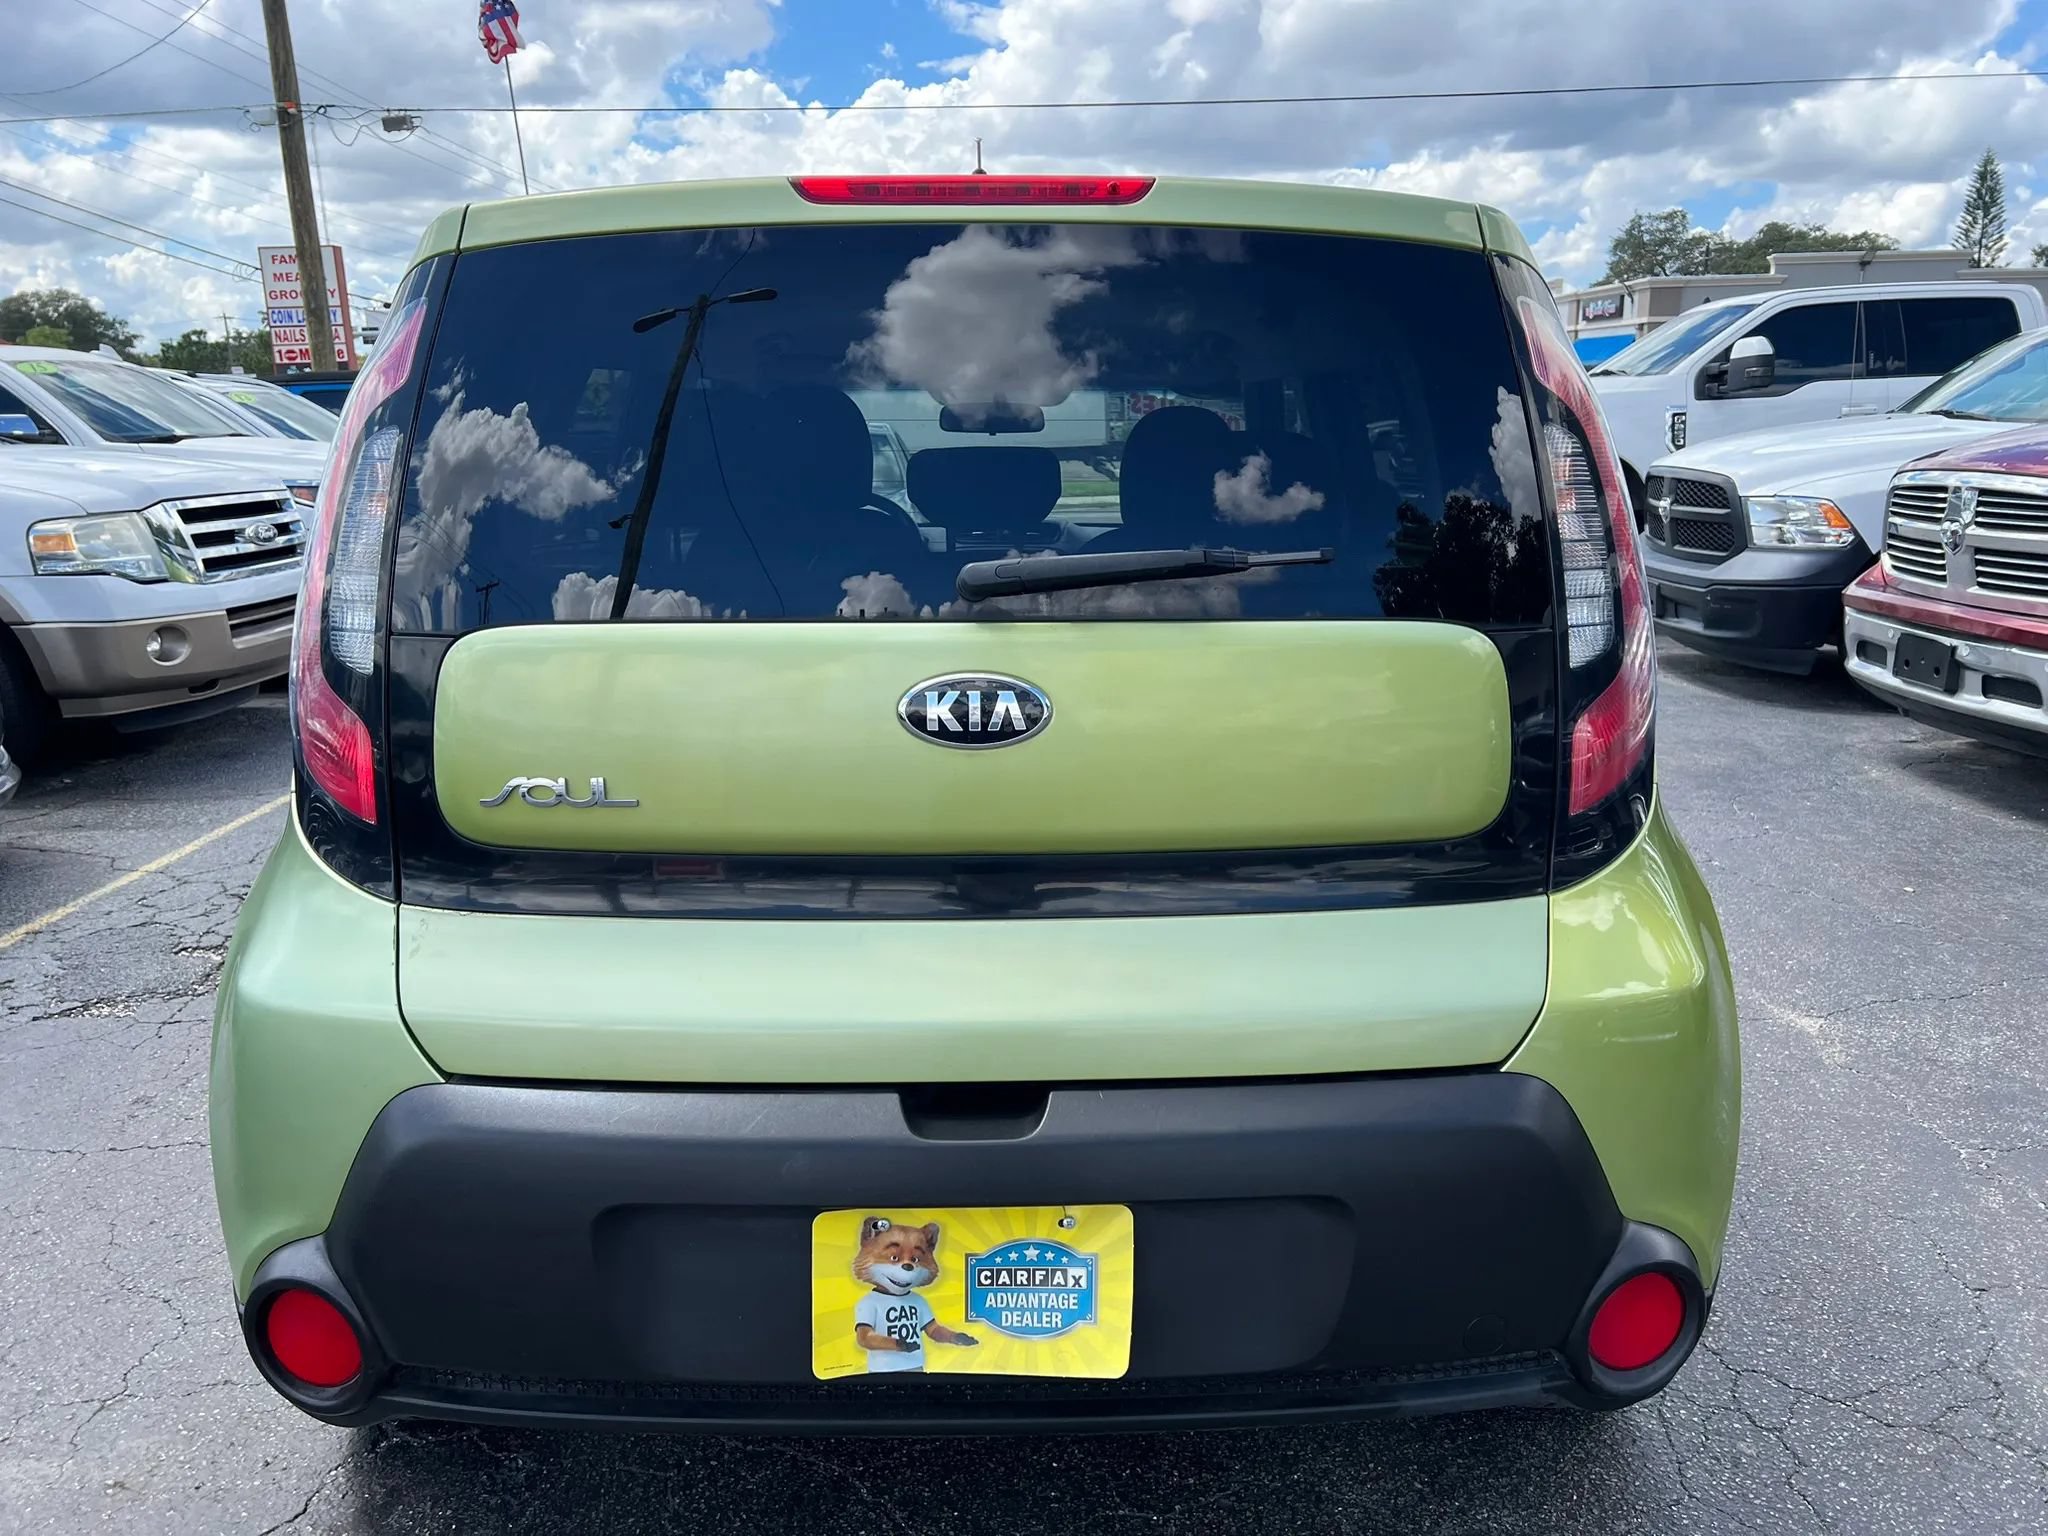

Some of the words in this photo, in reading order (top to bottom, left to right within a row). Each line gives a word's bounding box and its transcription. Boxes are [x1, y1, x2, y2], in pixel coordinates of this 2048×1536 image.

[271, 310, 294, 324] COIN
[275, 329, 306, 342] NAILS
[924, 690, 1027, 732] KIA
[479, 776, 640, 808] SOUL
[979, 1270, 1083, 1288] CARFAX
[985, 1292, 1079, 1310] ADVANTAGE
[885, 1305, 919, 1323] CAR
[1001, 1311, 1063, 1328] DEALER
[887, 1323, 919, 1340] FOX
